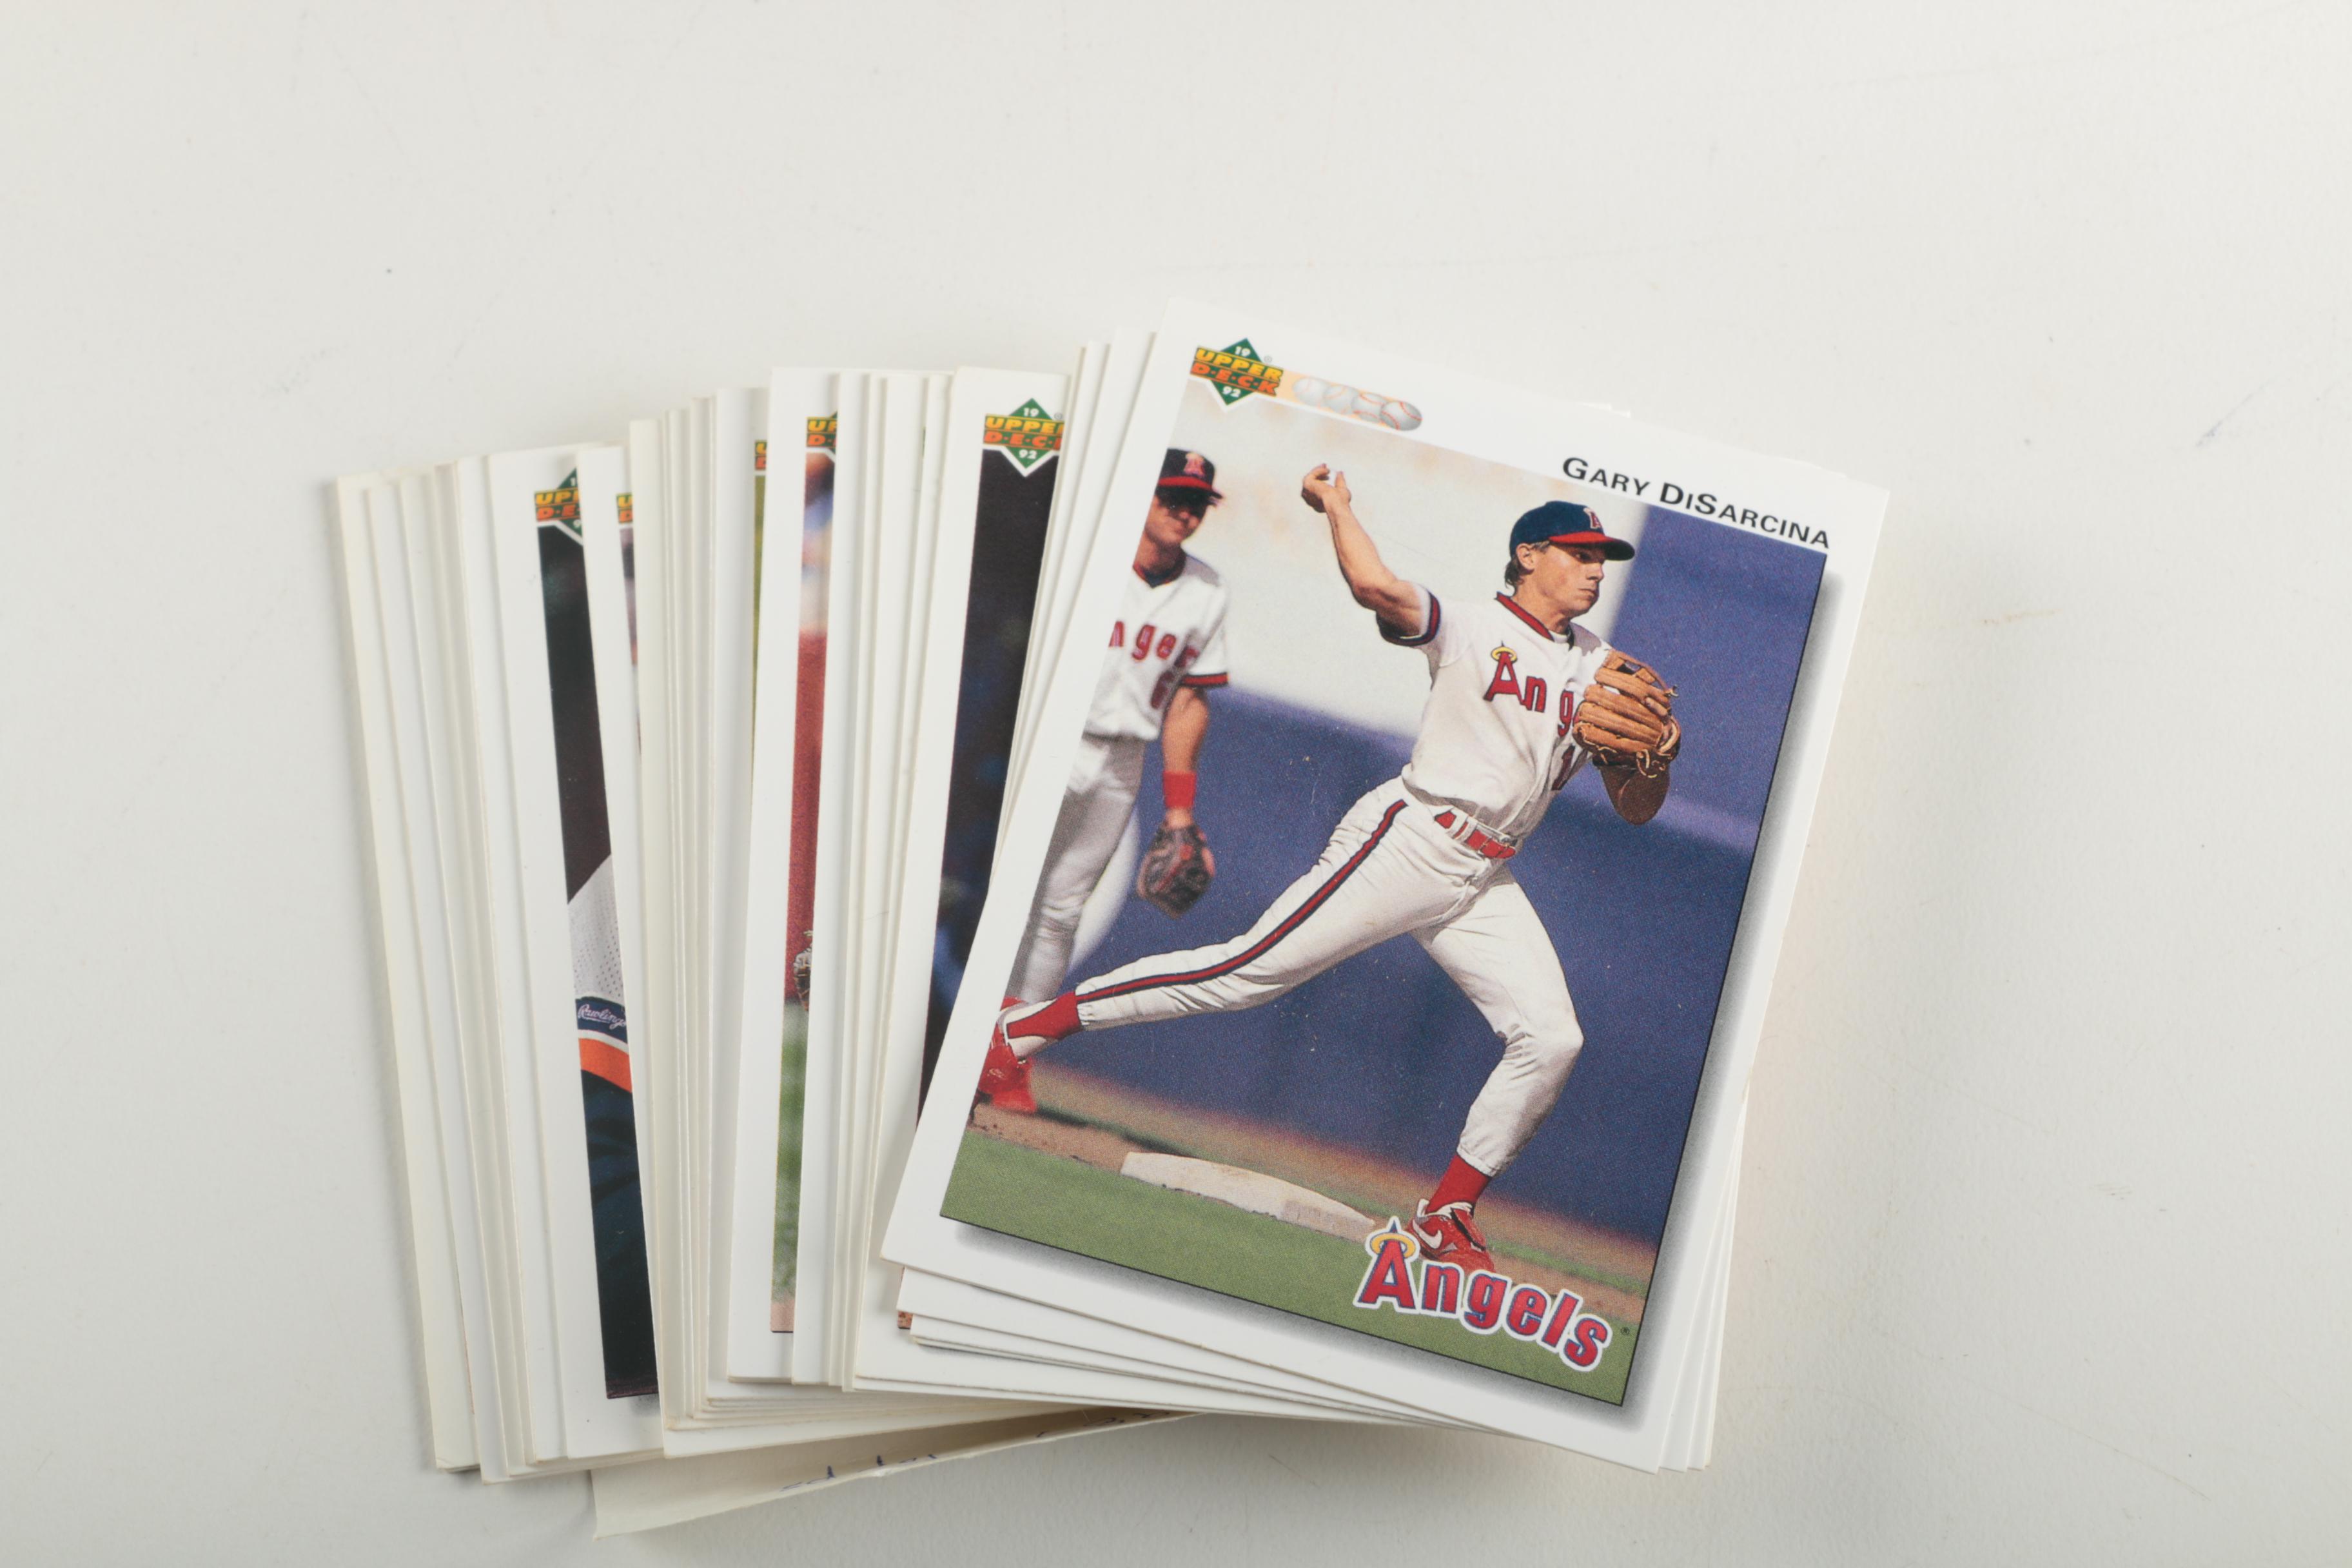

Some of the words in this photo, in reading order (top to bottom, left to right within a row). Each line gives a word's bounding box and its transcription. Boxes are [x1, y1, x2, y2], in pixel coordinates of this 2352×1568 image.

[1235, 346, 1251, 357] 19
[1195, 348, 1282, 382] UPPER
[1222, 386, 1241, 398] 92
[1023, 407, 1039, 417] 19
[1019, 449, 1037, 459] 92
[1562, 457, 1651, 497] GARY
[1483, 640, 1580, 737] Ang
[1355, 1217, 1611, 1369] Angels
